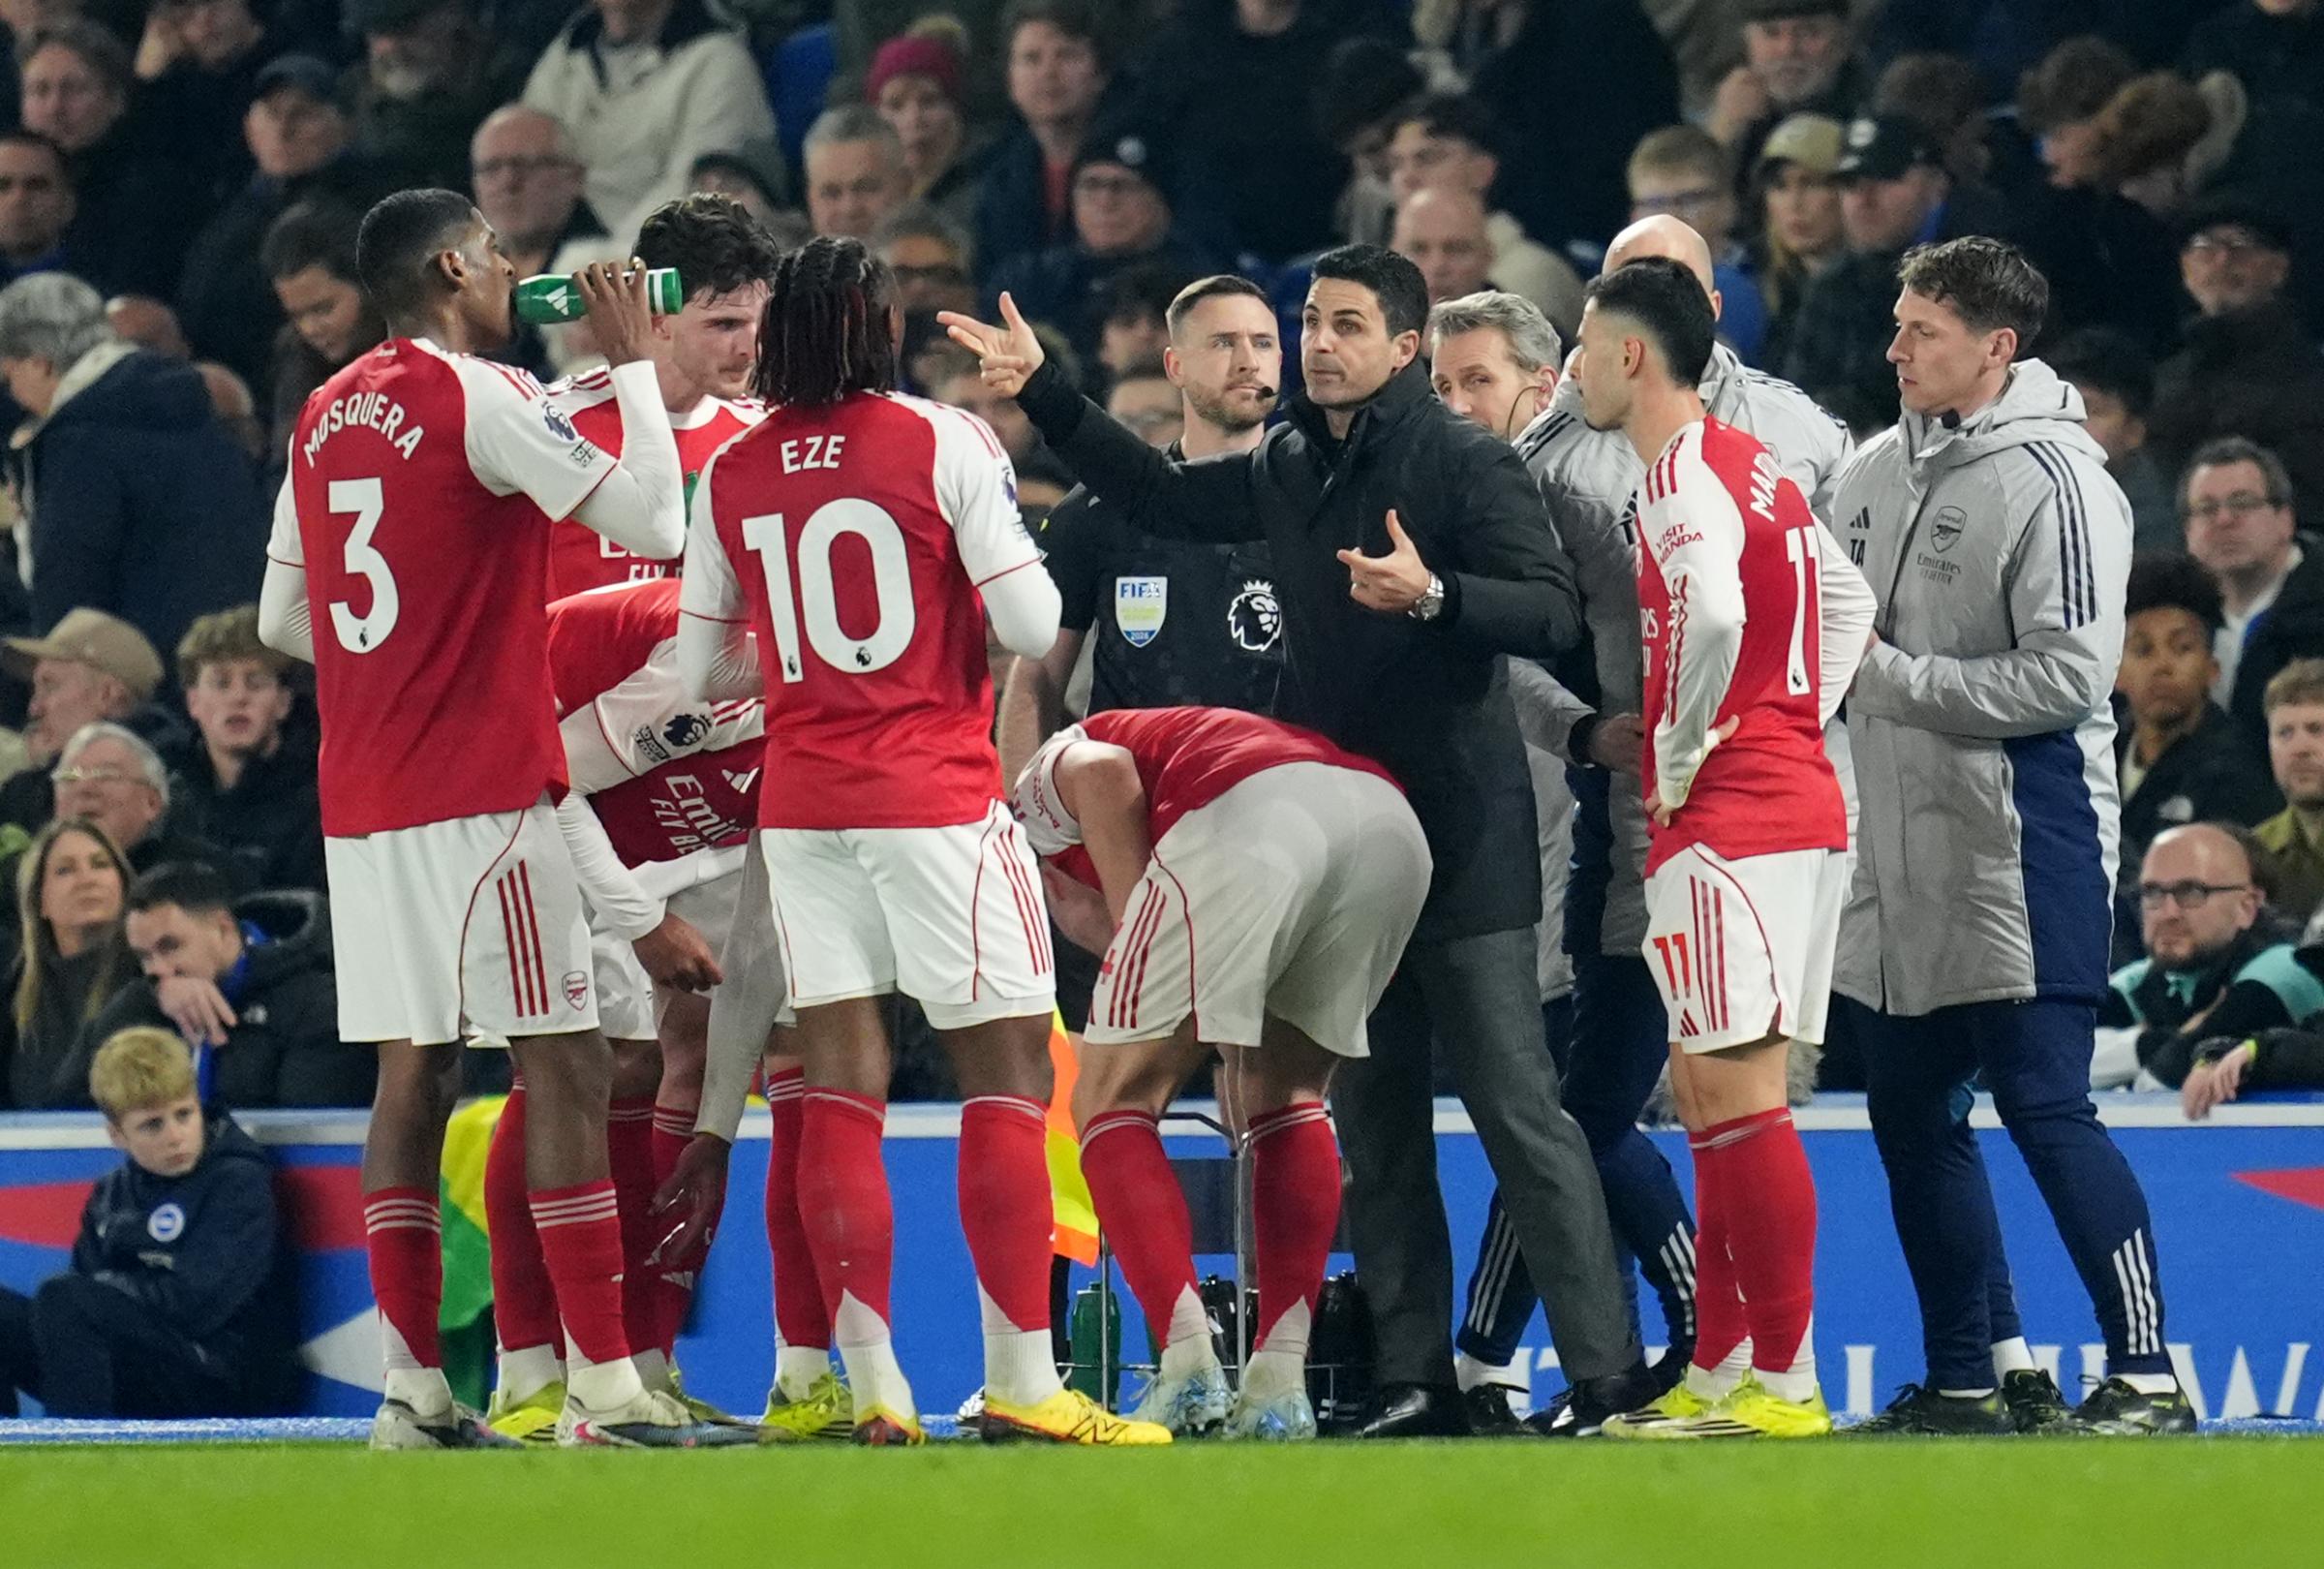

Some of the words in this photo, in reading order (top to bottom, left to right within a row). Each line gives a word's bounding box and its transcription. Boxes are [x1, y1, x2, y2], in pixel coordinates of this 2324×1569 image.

[303, 391, 424, 468] MOSQUERA
[780, 435, 845, 475] EZE
[329, 477, 399, 654] 3
[1656, 523, 1686, 549] VISIT
[1850, 538, 1866, 568] TA
[742, 498, 916, 684] 10
[1120, 583, 1161, 599] FIFA
[1785, 526, 1822, 695] 11
[650, 798, 689, 828] FLY
[665, 775, 743, 842] Emir
[1652, 933, 1691, 1000] 11
